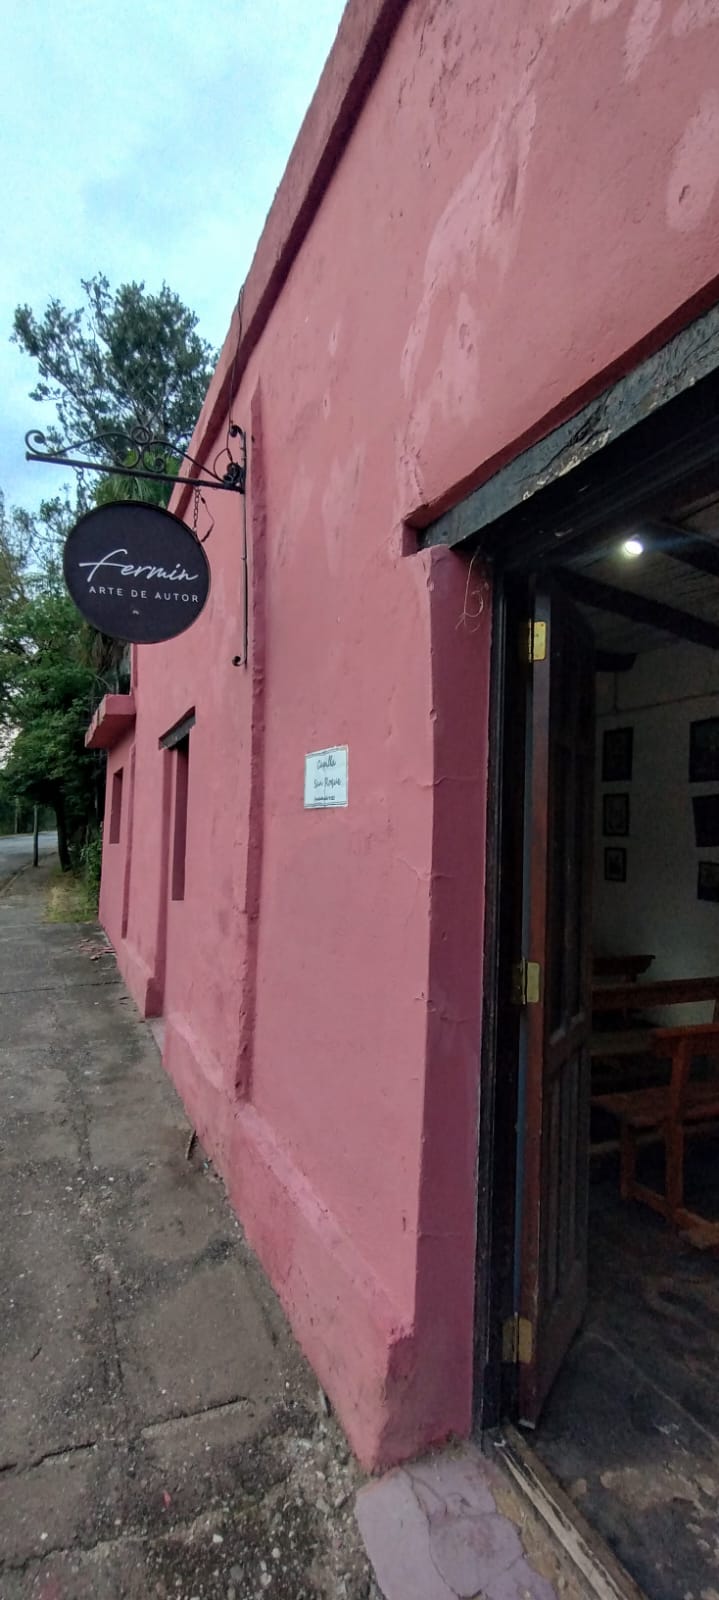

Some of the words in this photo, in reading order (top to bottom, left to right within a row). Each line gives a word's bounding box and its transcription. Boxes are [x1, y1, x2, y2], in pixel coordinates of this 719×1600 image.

[88, 586, 124, 596] ARTE
[131, 589, 148, 599] DE
[154, 592, 199, 603] AUTOR
